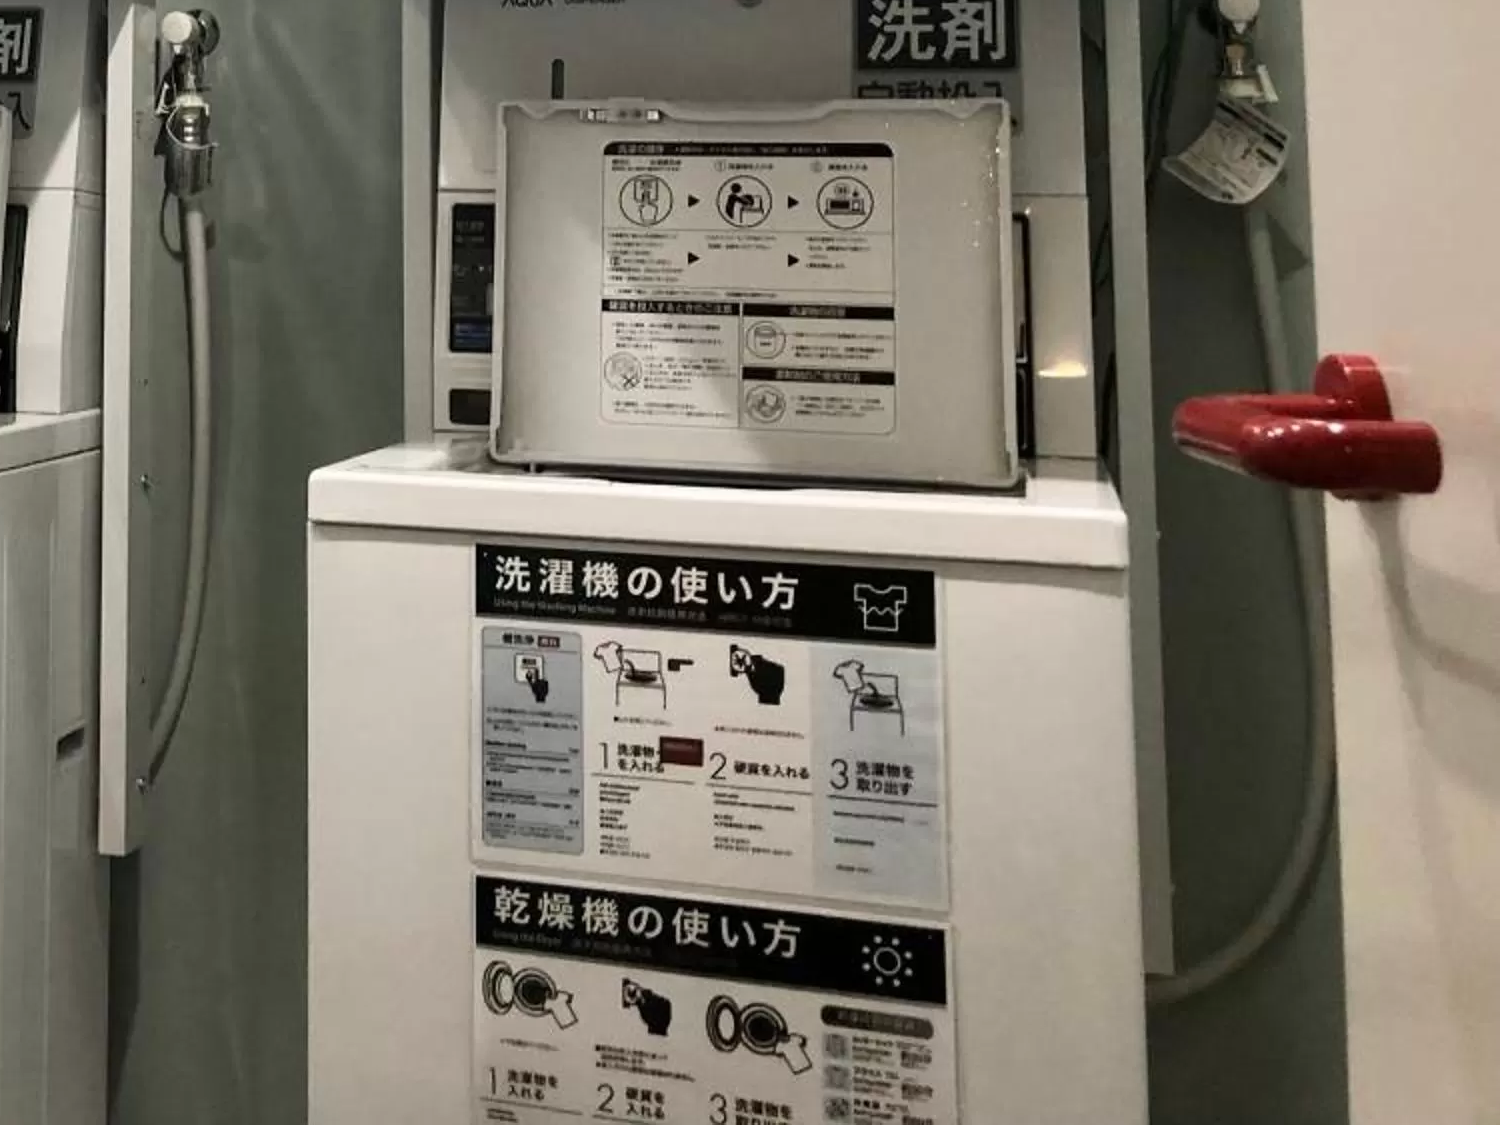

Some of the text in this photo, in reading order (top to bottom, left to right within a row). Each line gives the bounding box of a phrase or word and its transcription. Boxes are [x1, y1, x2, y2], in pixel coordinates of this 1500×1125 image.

[495, 554, 800, 611] 洗濯機の使い方
[709, 751, 727, 780] 2
[829, 757, 849, 790] 3
[494, 885, 801, 959] 乾燥機の使い方
[597, 1083, 614, 1114] 2
[709, 1092, 727, 1125] 3
